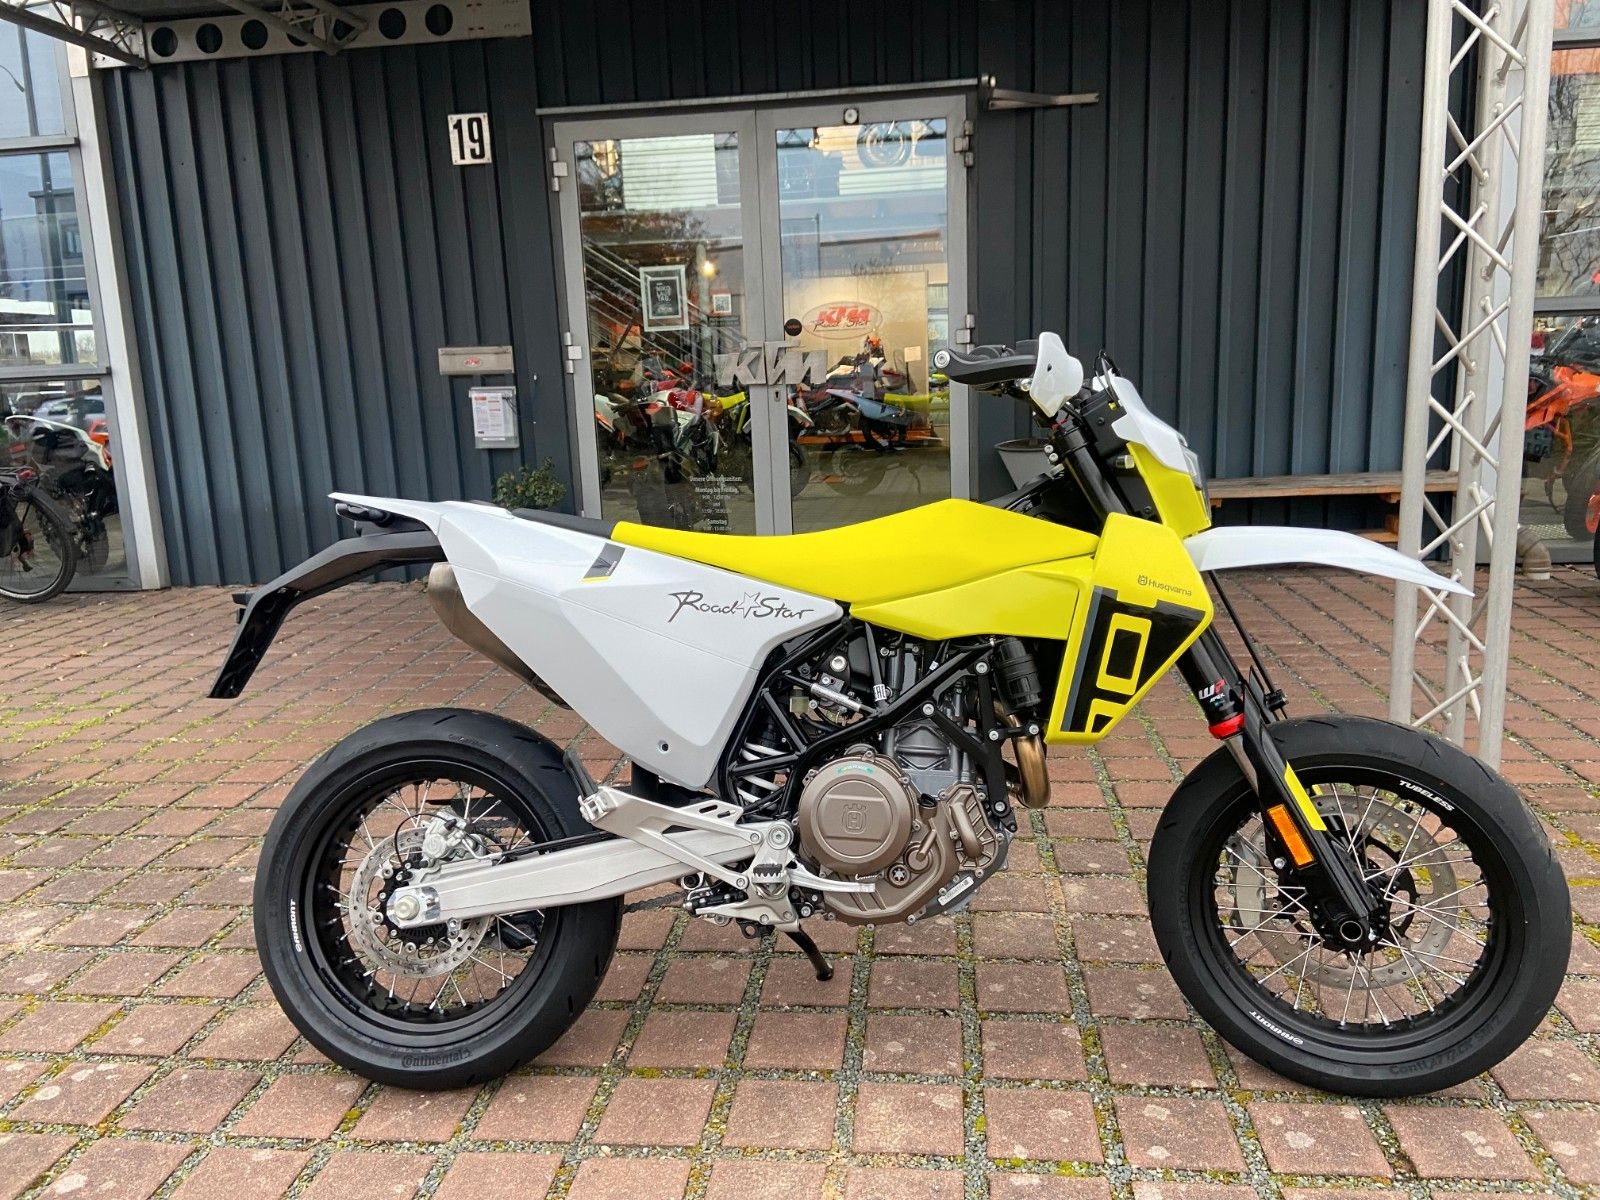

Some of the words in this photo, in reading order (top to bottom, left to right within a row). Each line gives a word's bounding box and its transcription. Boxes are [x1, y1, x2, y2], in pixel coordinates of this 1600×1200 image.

[453, 117, 486, 160] 19
[815, 306, 871, 324] KTM
[712, 341, 828, 386] KTM
[1148, 578, 1193, 597] Husqvarna
[668, 590, 739, 623] Road
[753, 597, 814, 619] Star
[1399, 780, 1456, 812] TUBELESS
